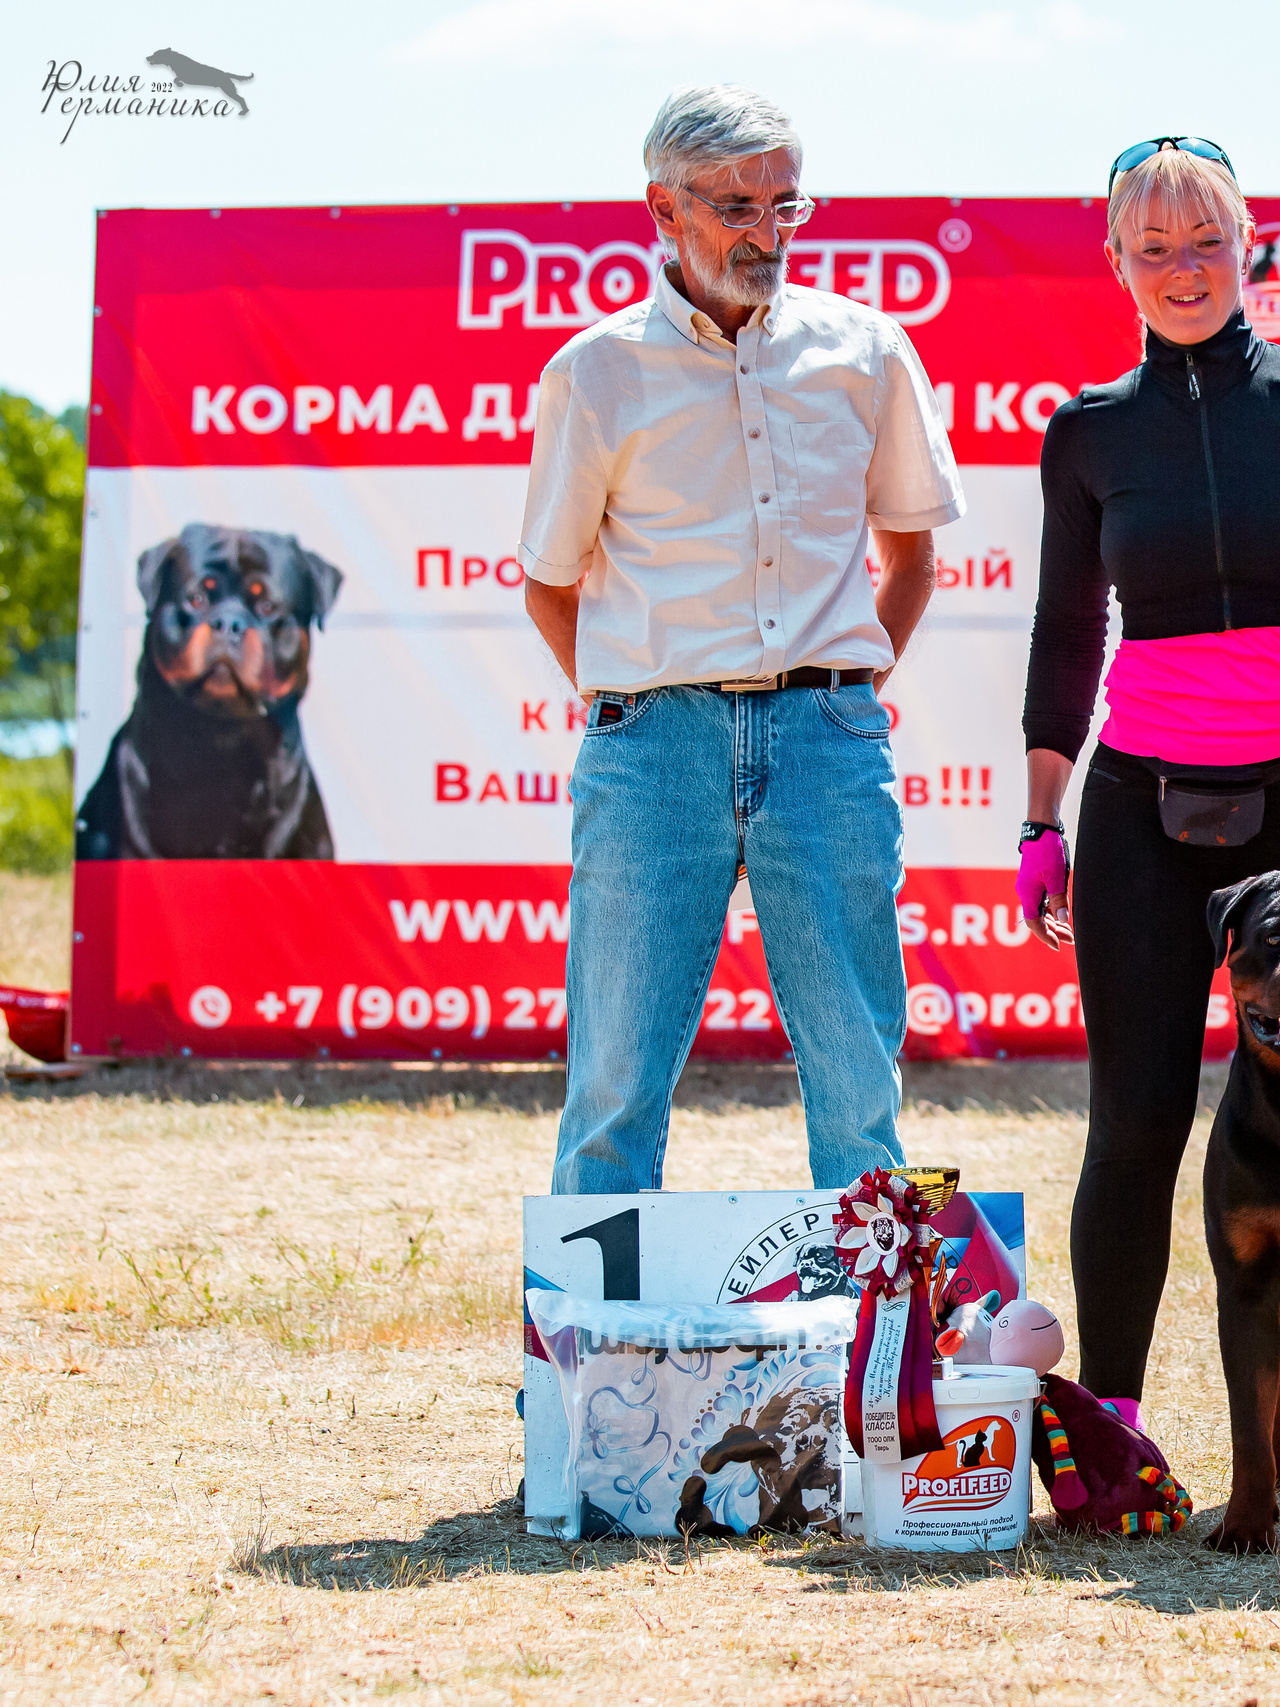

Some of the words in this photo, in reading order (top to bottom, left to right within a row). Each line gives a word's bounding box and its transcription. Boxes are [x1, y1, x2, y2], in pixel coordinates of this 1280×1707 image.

[191, 383, 449, 434] КОРМА
[255, 985, 323, 1029] +7
[337, 984, 492, 1040] (909)
[560, 1208, 641, 1301] 1
[865, 1411, 896, 1421] ПОБЕДИТЕЛЬ
[865, 1421, 895, 1431] КЛАССА
[874, 1444, 889, 1452] Тверь
[902, 1472, 1012, 1497] PROFIFEED
[902, 1517, 988, 1530] Профессиональный
[990, 1514, 1014, 1526] подход
[901, 1528, 949, 1537] кормлению
[951, 1528, 980, 1537] Ваших
